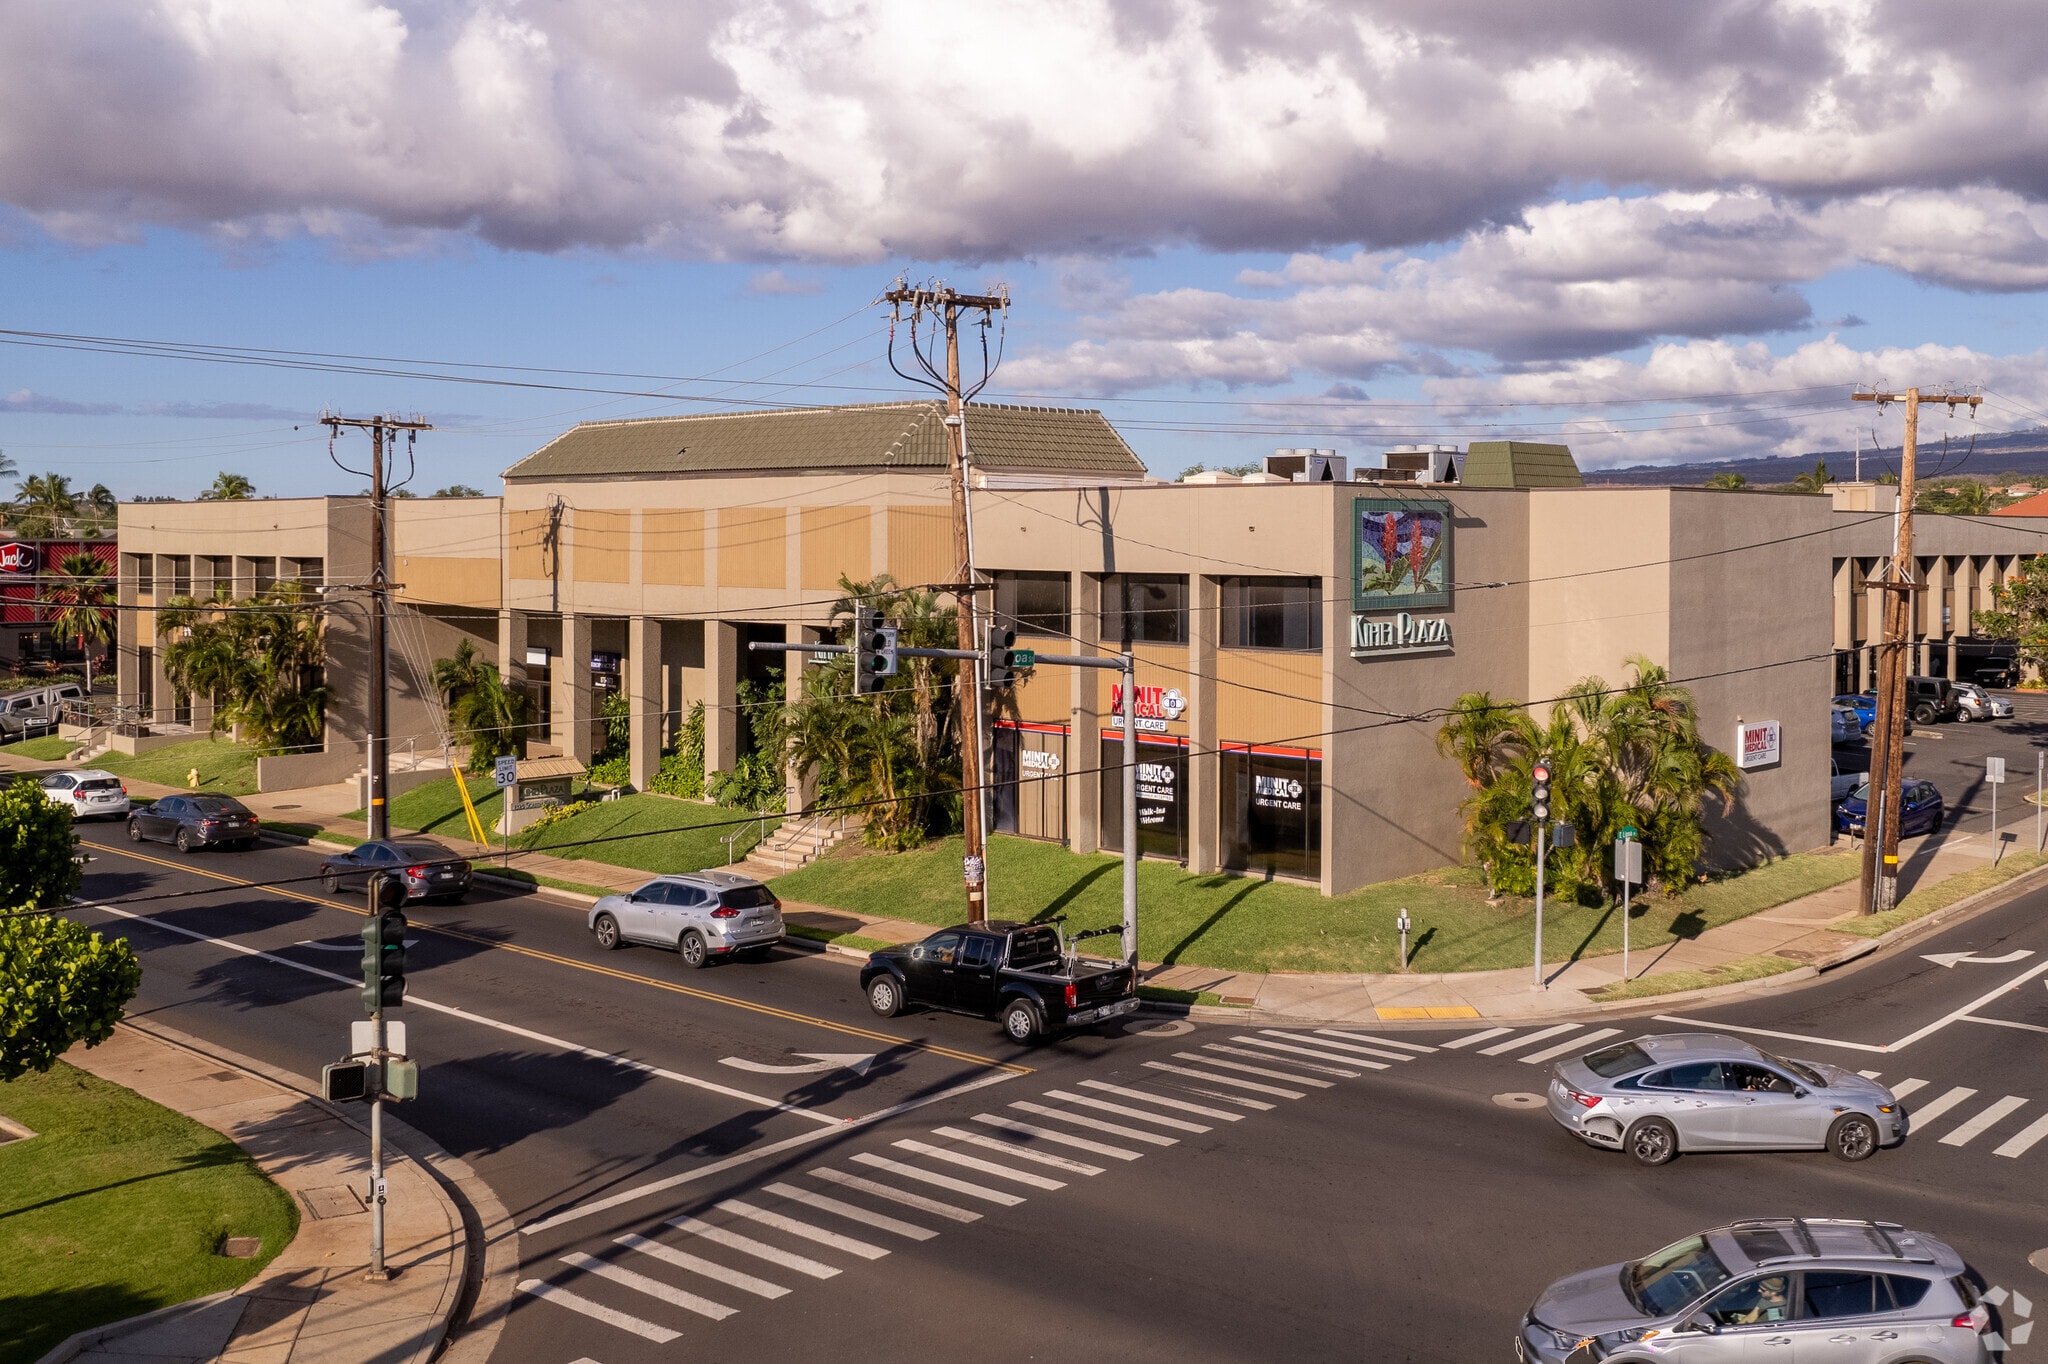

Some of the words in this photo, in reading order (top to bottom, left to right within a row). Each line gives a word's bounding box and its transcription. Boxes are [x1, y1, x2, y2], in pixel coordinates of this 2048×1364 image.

[0, 547, 33, 567] Jack
[1111, 683, 1163, 705] MNIT
[1111, 701, 1164, 717] MICAL
[1144, 720, 1164, 730] CARE
[1745, 728, 1767, 743] MINIT
[1745, 741, 1767, 753] MEDICAL
[1022, 750, 1050, 762] MINIT
[1022, 760, 1050, 769] MEDICAL
[497, 771, 515, 784] 30
[1022, 770, 1043, 778] URGENT
[1255, 775, 1289, 790] MINIT
[541, 784, 564, 796] PLAZA
[1156, 785, 1174, 795] CARE
[1255, 786, 1289, 797] MEDICAL
[1255, 797, 1282, 807] URGENT
[1282, 800, 1302, 810] CARE
